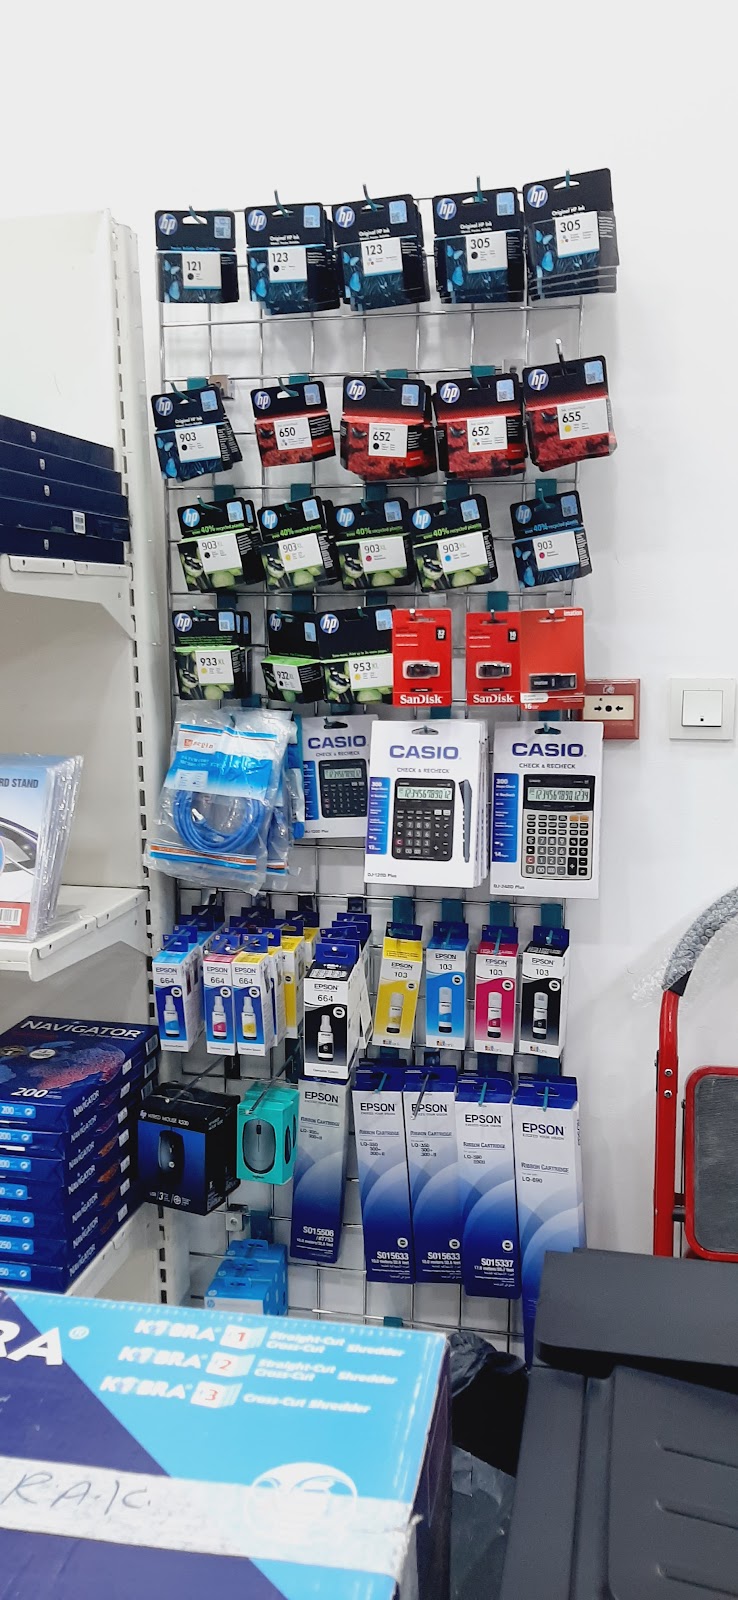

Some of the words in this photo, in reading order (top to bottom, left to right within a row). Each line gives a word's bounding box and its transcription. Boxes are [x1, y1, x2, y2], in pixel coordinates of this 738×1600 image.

[560, 220, 580, 232] 305
[471, 238, 490, 250] 305
[365, 245, 382, 258] 123
[272, 252, 288, 265] 123
[187, 261, 202, 271] 121
[562, 411, 581, 423] 655
[180, 433, 196, 442] 903
[279, 427, 295, 437] 650
[373, 431, 391, 443] 652
[472, 426, 490, 438] 652
[201, 525, 215, 533] 40%
[280, 528, 293, 536] 40%
[356, 528, 371, 536] 40%
[433, 528, 449, 537] 40%
[537, 540, 553, 550] 903
[400, 693, 442, 704] SanDisk
[473, 693, 514, 704] SanDisk
[308, 736, 366, 749] CASIO
[389, 745, 458, 759] CASIO
[512, 743, 583, 757] CASIO
[12, 778, 39, 792] STAND
[391, 962, 413, 970] EPSON
[486, 959, 508, 967] EPSON
[314, 984, 338, 992] EPSON
[317, 995, 333, 1003] 664
[20, 1020, 142, 1038] NAVIGATOR
[11, 1088, 48, 1098] 200
[304, 1091, 338, 1103] EPSON
[73, 1090, 99, 1117] NAVIGATOR
[360, 1103, 395, 1116] EPSON
[412, 1104, 447, 1117] EPSON
[465, 1114, 502, 1124] EPSON
[71, 1114, 97, 1143] NAVIGATOR
[522, 1122, 564, 1136] EPSON
[69, 1140, 95, 1170] NAVIGATOR
[68, 1164, 96, 1195] NAVIGATOR
[72, 1192, 98, 1223] NAVIGATOR
[73, 1216, 98, 1248] NAVIGATOR
[70, 1243, 96, 1277] NAVIGATOR
[377, 1252, 409, 1261] S015633
[427, 1252, 460, 1262] S015633
[481, 1258, 514, 1268] S015337
[266, 1341, 325, 1354] Cross-Cut
[346, 1344, 404, 1358] Shredder
[219, 1359, 231, 1371] 2
[254, 1368, 315, 1383] Cross-Cut
[337, 1371, 398, 1385] Shredder
[205, 1389, 218, 1401] 3
[243, 1392, 307, 1408] Cross-Cut
[308, 1399, 371, 1413] Shredder
